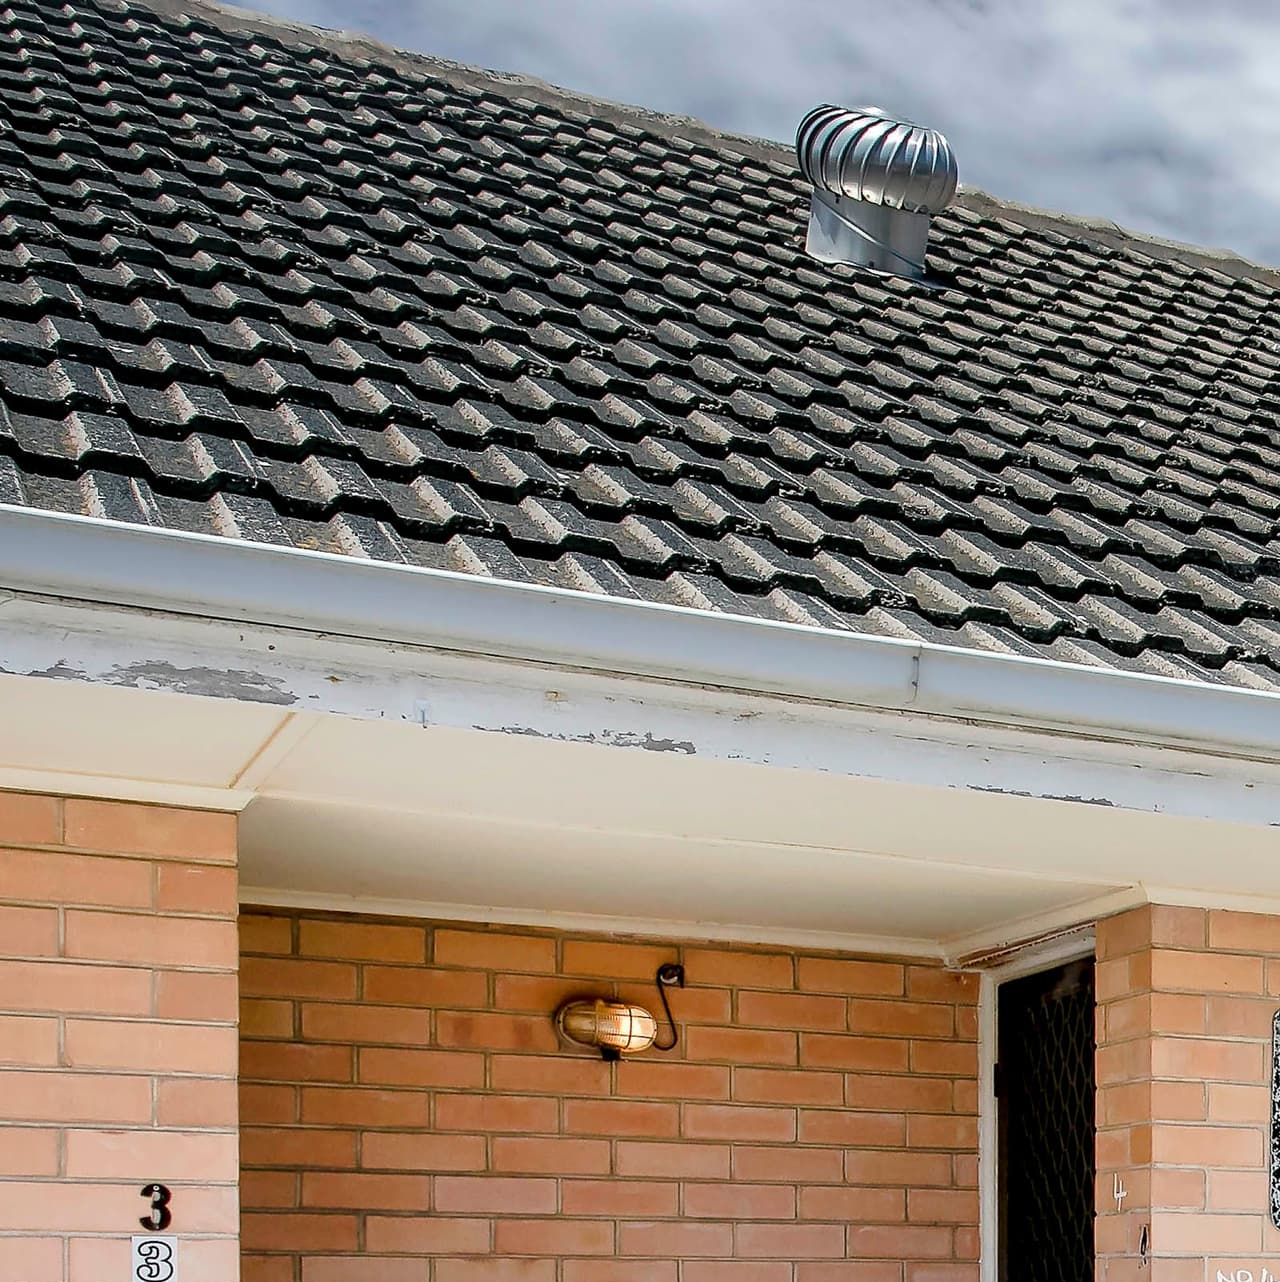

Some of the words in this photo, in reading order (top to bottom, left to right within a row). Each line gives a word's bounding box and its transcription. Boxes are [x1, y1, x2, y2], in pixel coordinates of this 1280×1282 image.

[139, 1184, 172, 1231] 3
[1113, 1172, 1129, 1213] 4
[137, 1241, 173, 1282] 3
